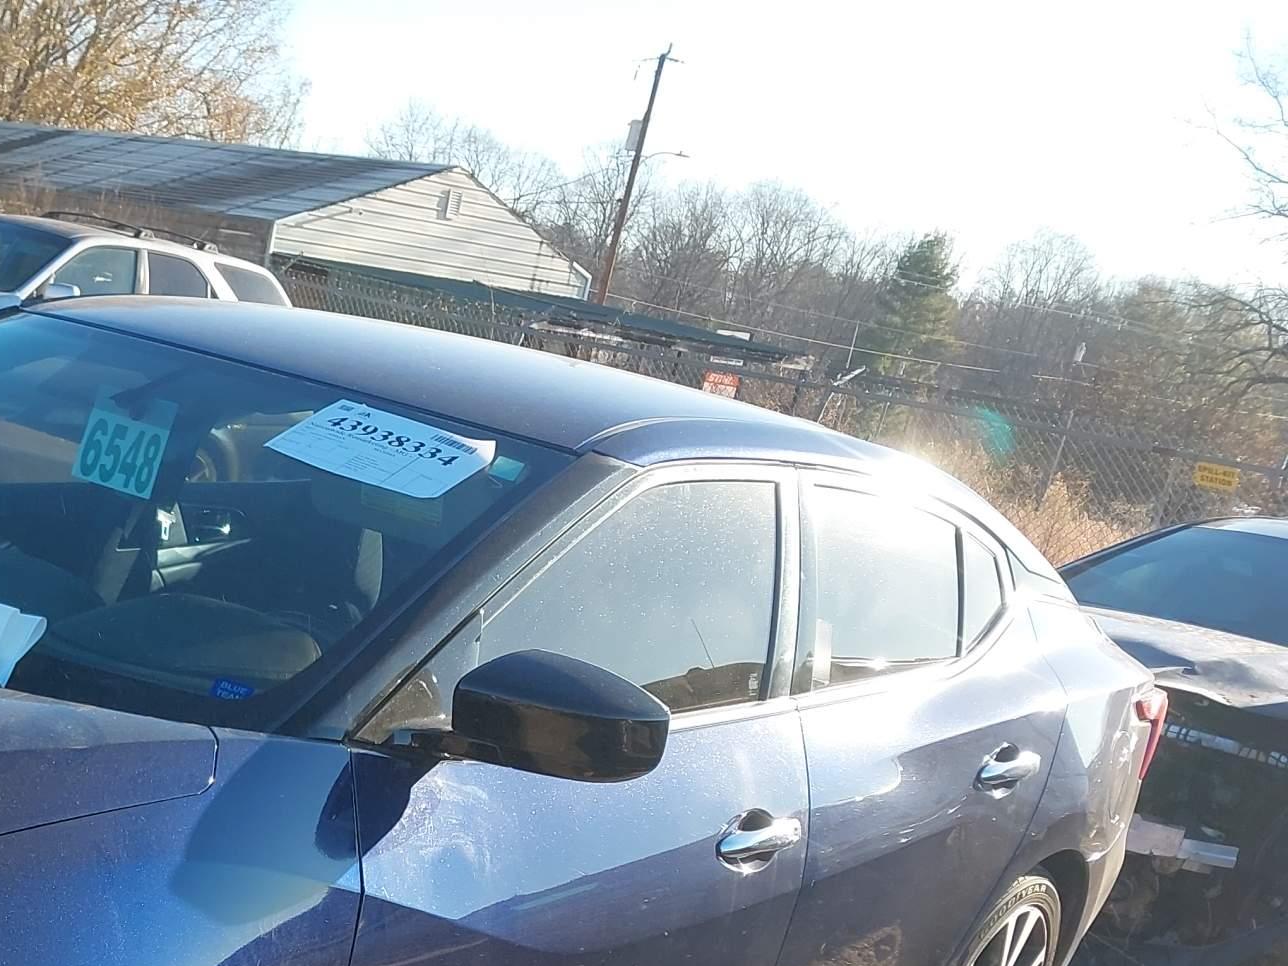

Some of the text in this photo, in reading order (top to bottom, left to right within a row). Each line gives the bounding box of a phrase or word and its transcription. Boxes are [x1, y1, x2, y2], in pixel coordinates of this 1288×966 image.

[80, 418, 162, 494] 6548
[327, 416, 460, 467] 43938334
[1199, 474, 1233, 487] STATION
